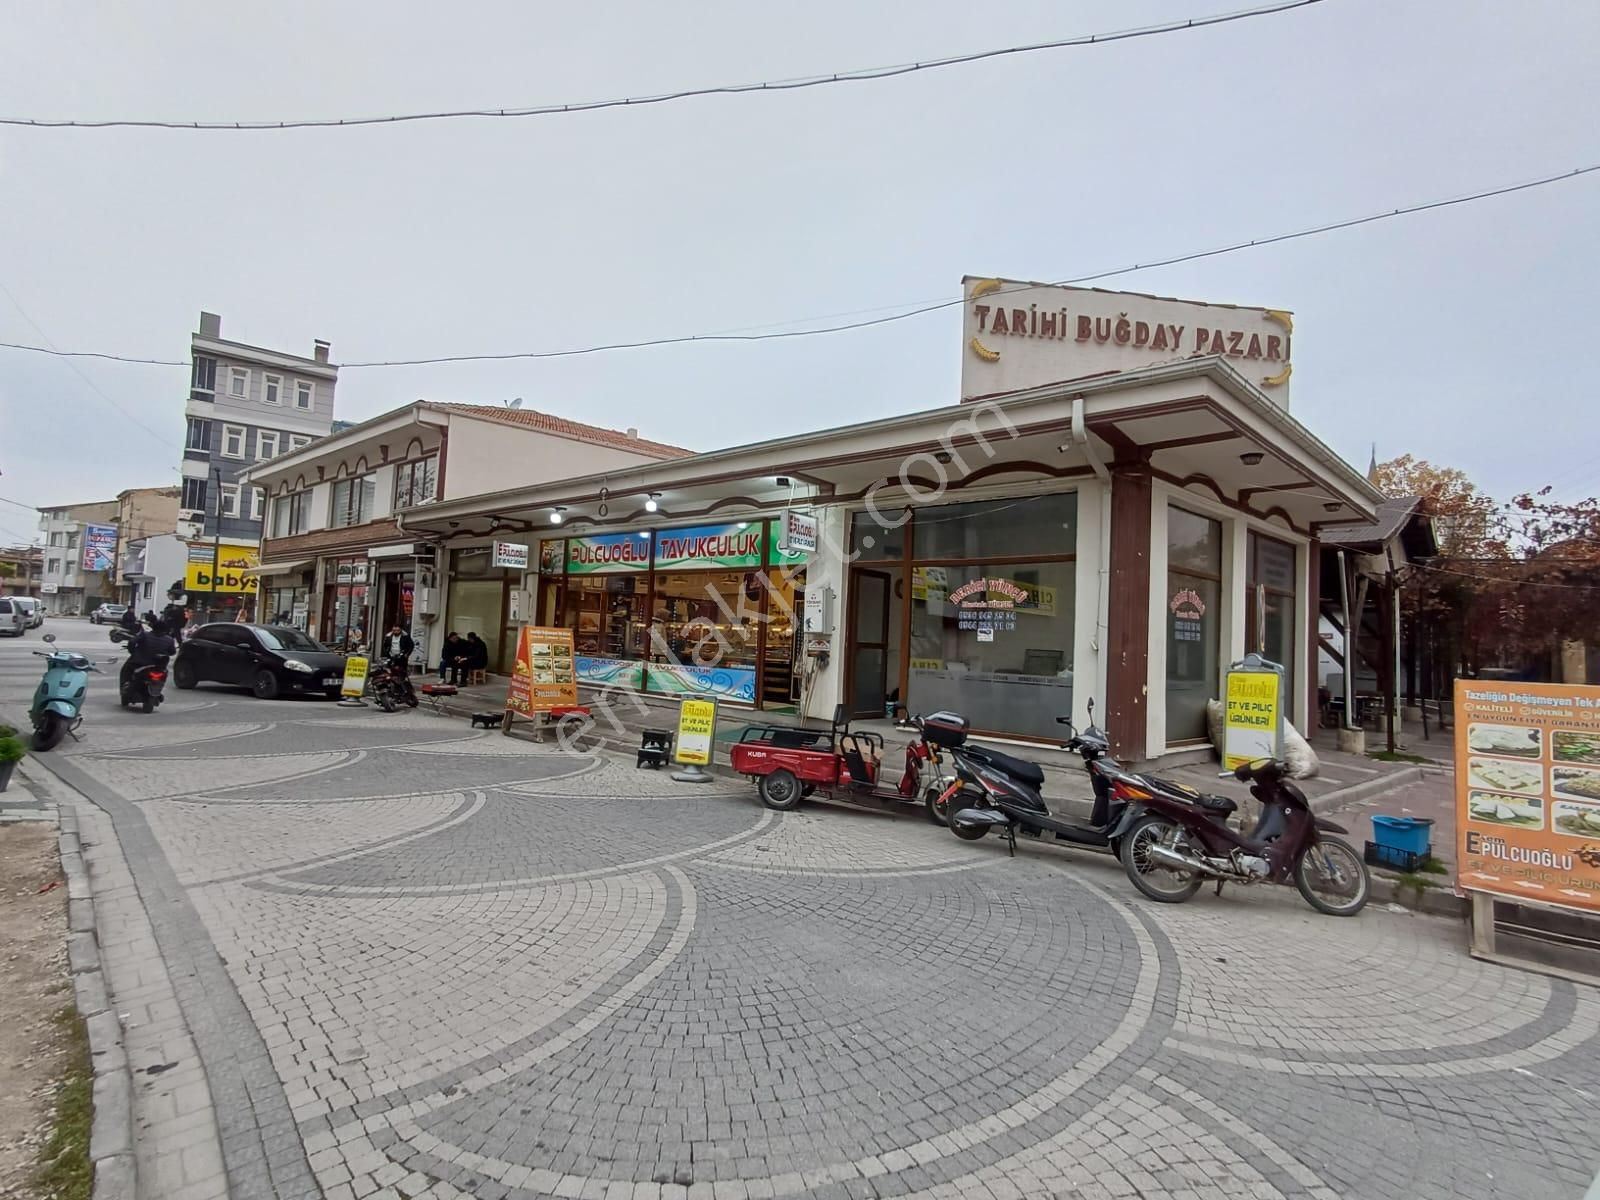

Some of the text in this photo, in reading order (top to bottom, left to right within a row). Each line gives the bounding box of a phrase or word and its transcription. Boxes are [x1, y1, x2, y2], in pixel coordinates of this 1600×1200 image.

[974, 302, 1292, 361] TARİHİ BUĞDAY PAZARI
[572, 537, 648, 564] PULCUOĞLU
[197, 572, 258, 591] babys
[1239, 701, 1250, 711] VE
[1464, 690, 1508, 702] Tazeliğin
[1510, 692, 1573, 707] Değişmeyen
[1575, 696, 1593, 707] Tek
[1481, 841, 1573, 871] PULCUOĞLU
